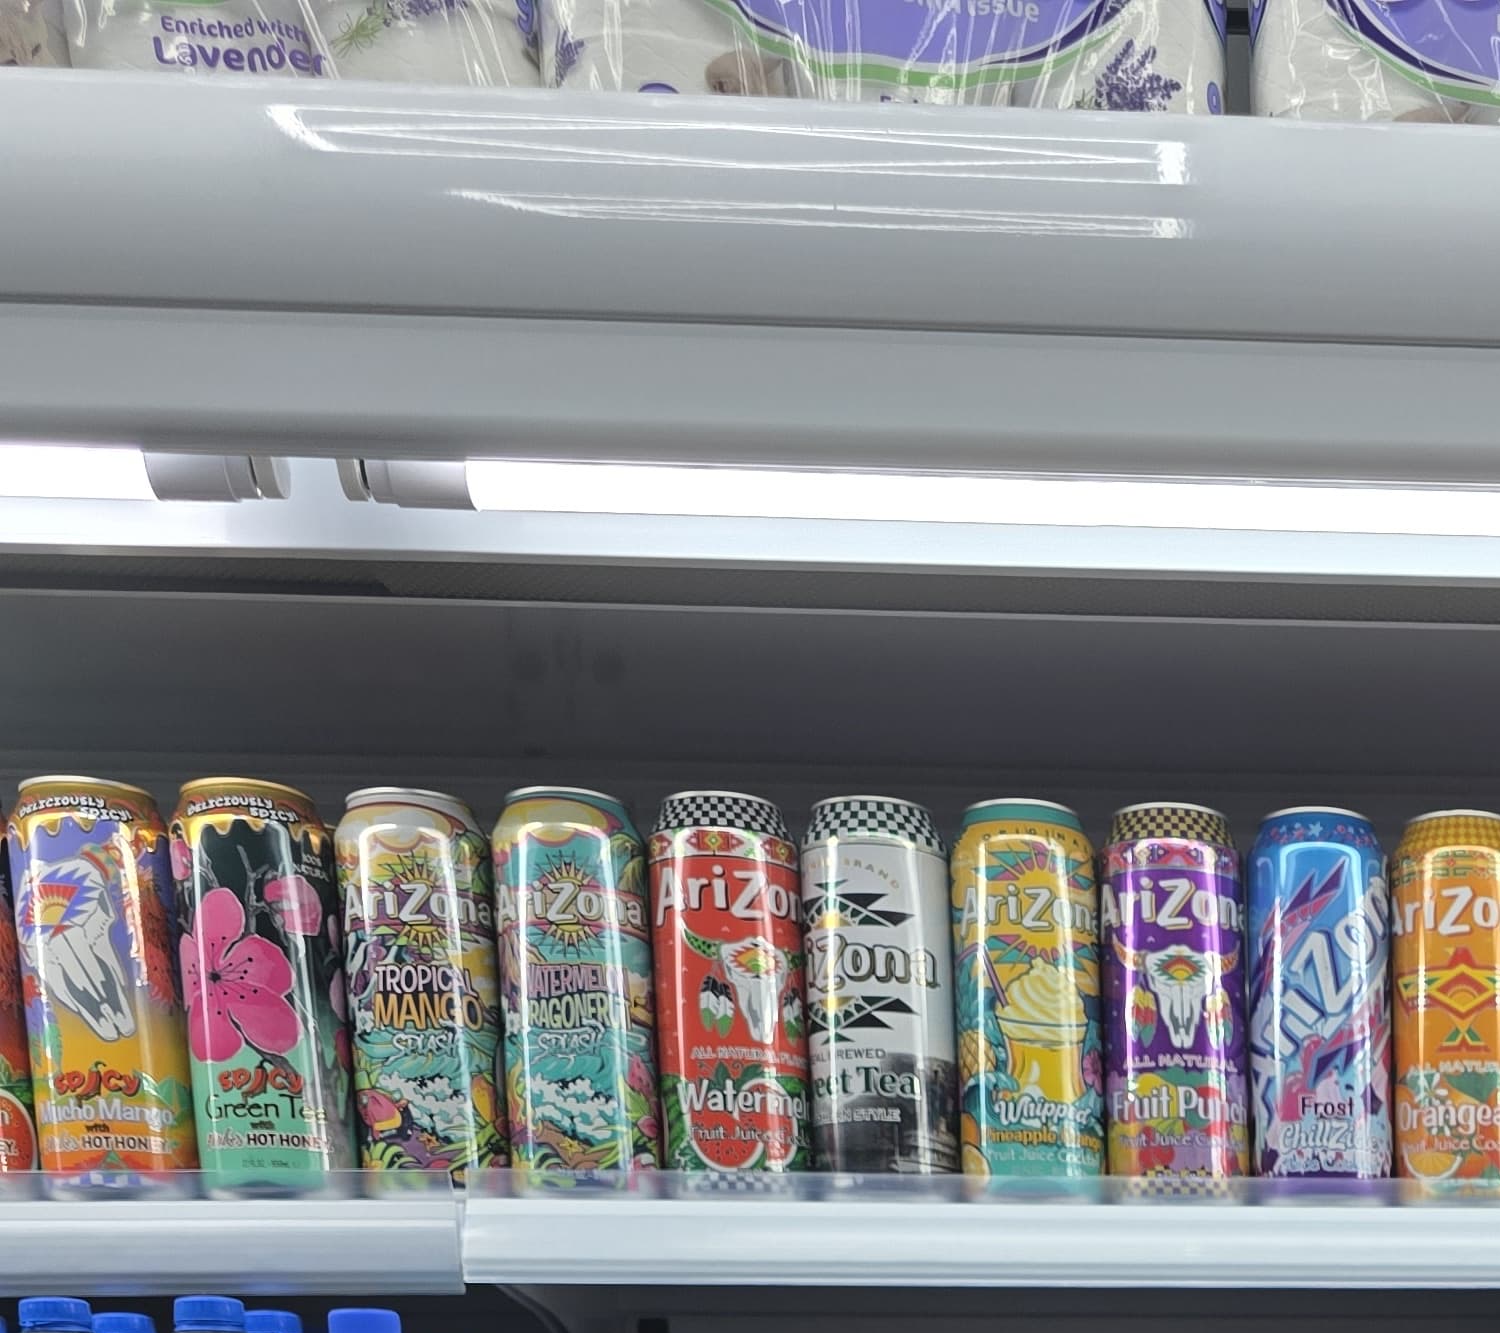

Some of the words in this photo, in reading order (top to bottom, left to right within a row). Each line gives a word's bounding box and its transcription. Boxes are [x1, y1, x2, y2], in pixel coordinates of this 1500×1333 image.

[160, 15, 252, 40] Enriched
[257, 17, 309, 44] with
[152, 38, 324, 76] Lavender
[346, 884, 490, 922] AriZona
[498, 882, 647, 926] AriZona
[376, 965, 473, 994] TROPICAL
[373, 992, 482, 1030] MANGO
[1112, 1090, 1174, 1122] Fruit
[1179, 1087, 1247, 1120] Punch
[1301, 1097, 1354, 1117] Frost
